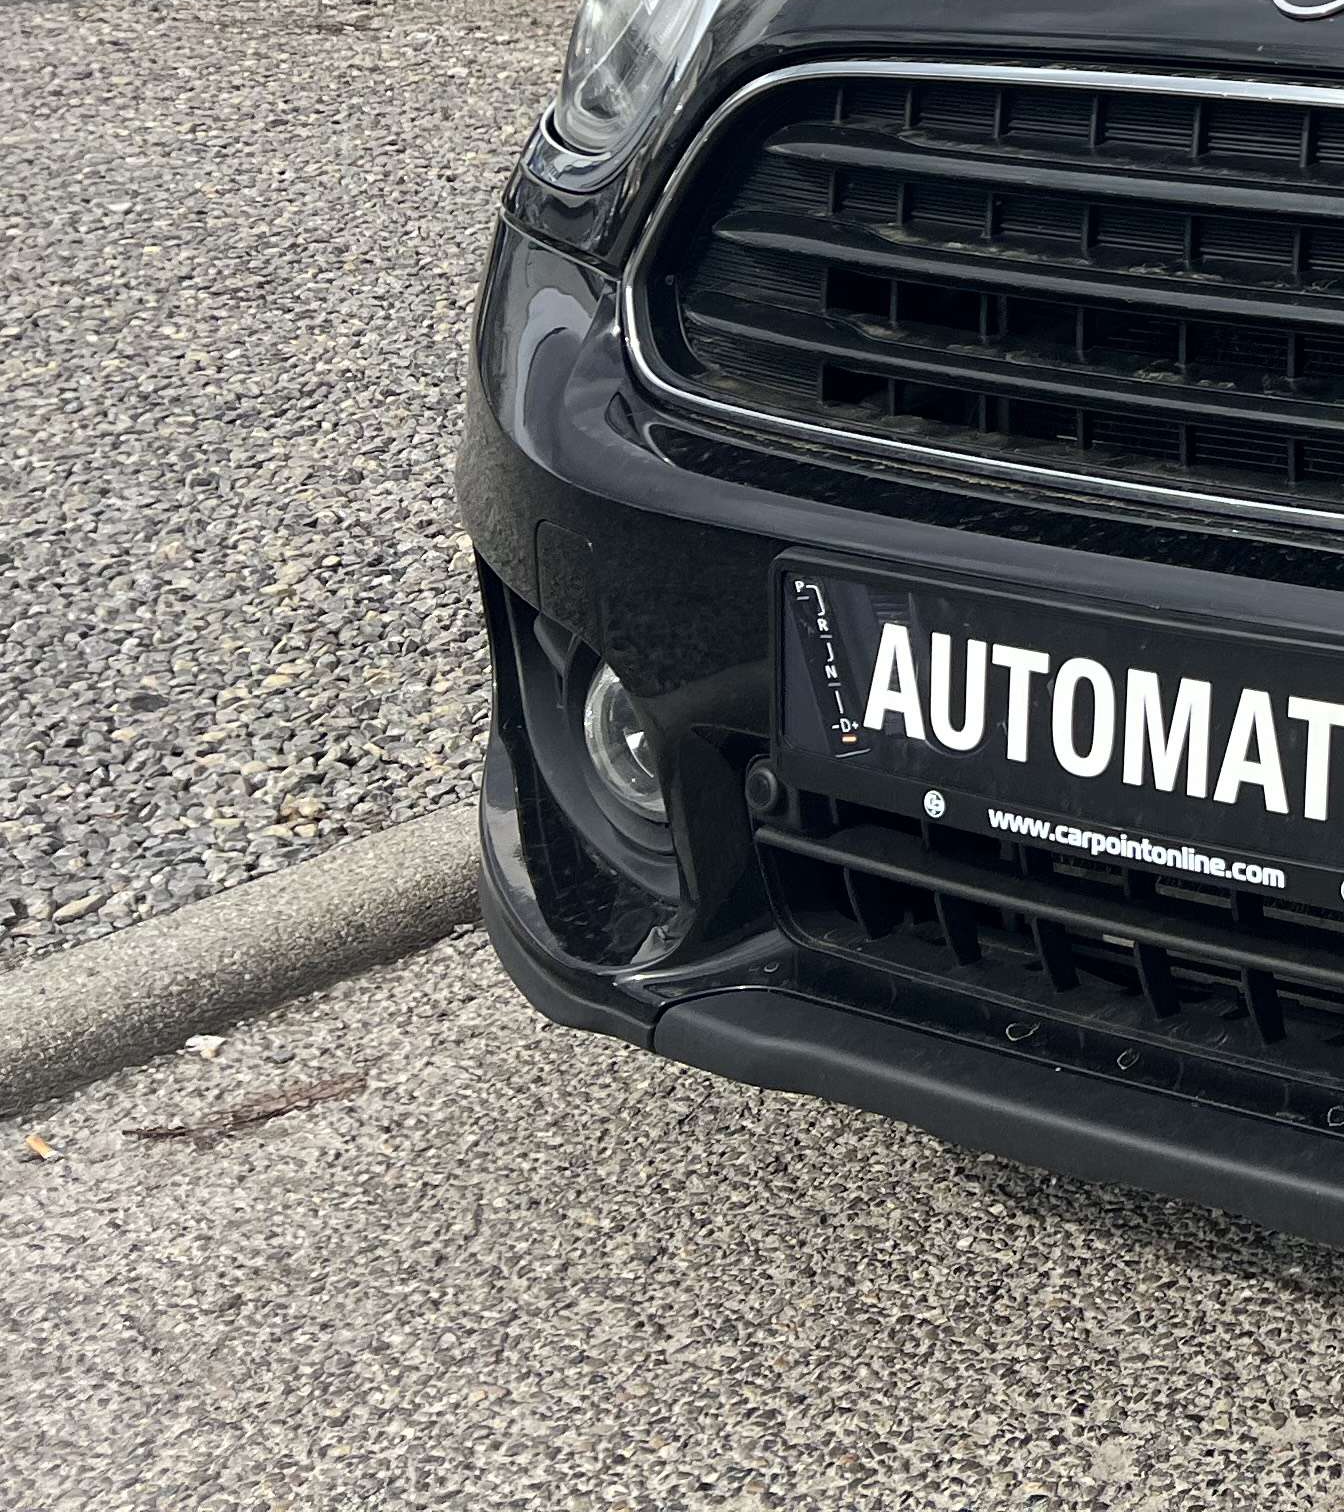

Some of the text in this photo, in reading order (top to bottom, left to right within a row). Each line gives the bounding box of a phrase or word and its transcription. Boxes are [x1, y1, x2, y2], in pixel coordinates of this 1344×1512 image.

[795, 580, 805, 593] P
[817, 618, 829, 632] R
[825, 664, 838, 679] N
[988, 808, 1286, 889] www.carpointonline.com
